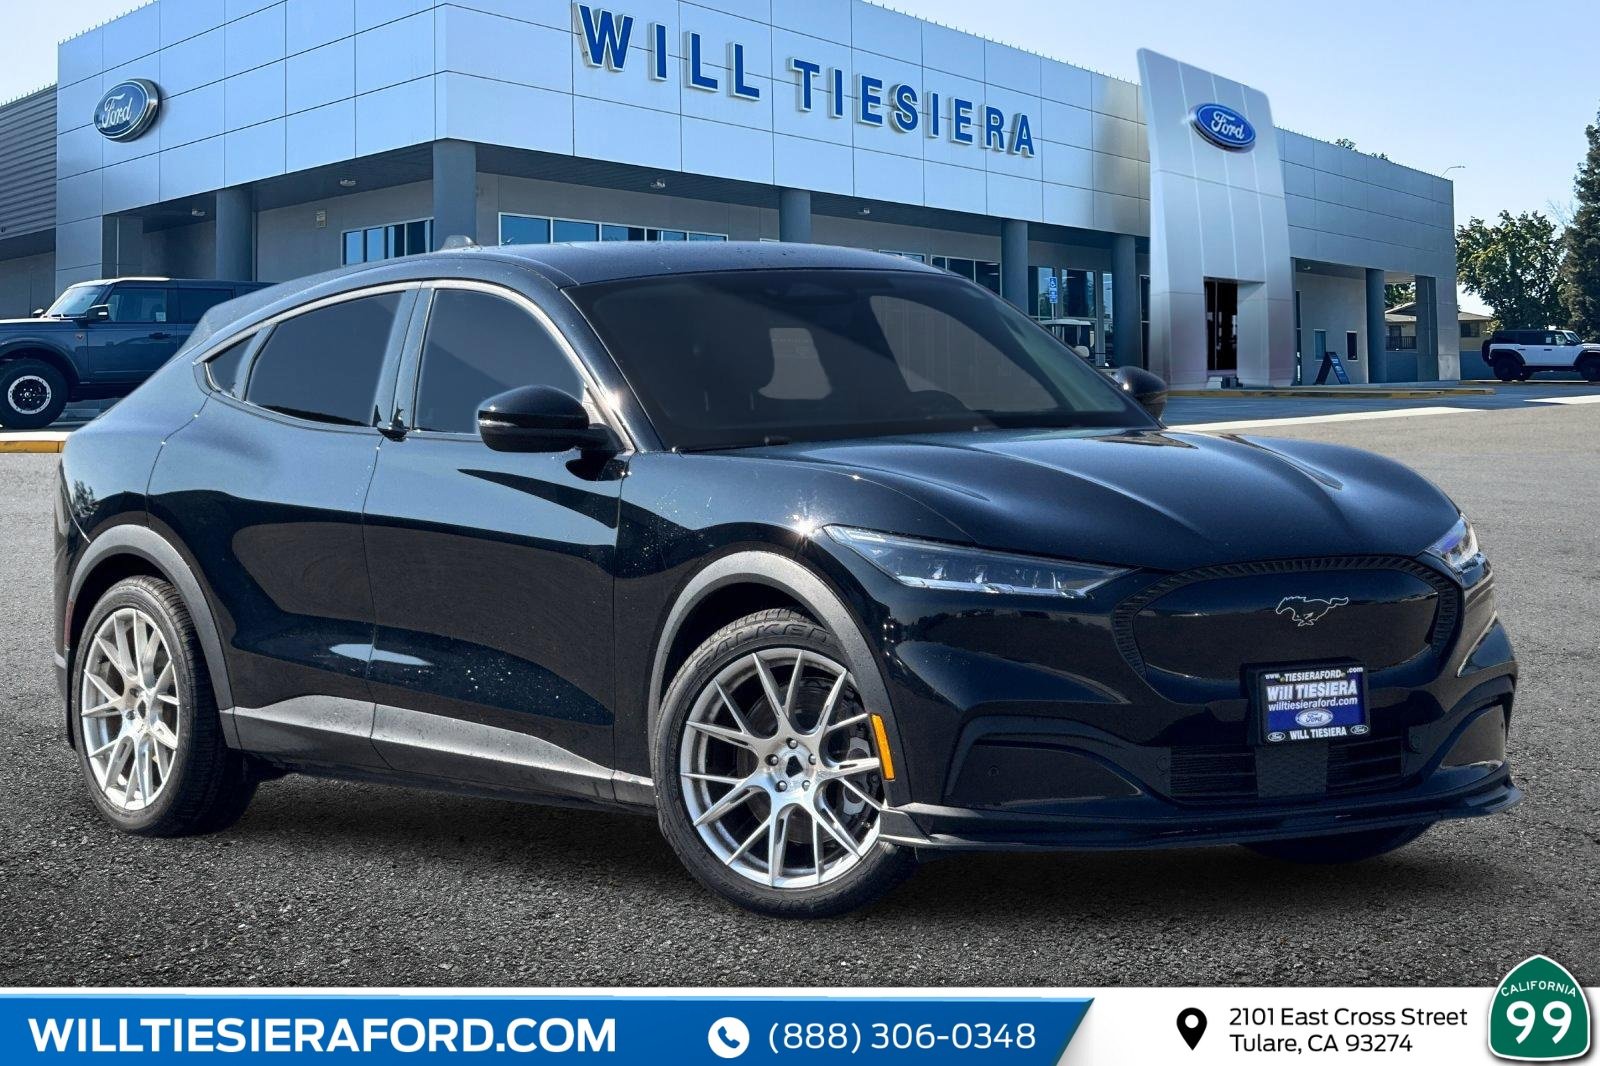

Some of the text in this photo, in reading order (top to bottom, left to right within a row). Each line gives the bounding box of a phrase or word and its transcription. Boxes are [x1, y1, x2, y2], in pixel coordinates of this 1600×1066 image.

[574, 2, 1036, 157] WILL TIESIERA
[101, 93, 133, 128] Ford
[1211, 111, 1244, 139] Ford
[1284, 669, 1341, 682] TIESIERAFORD
[1295, 679, 1358, 699] TIESIERA
[1268, 697, 1358, 711] willtiesieraford.com
[1289, 726, 1347, 740] WILL TIESIERA
